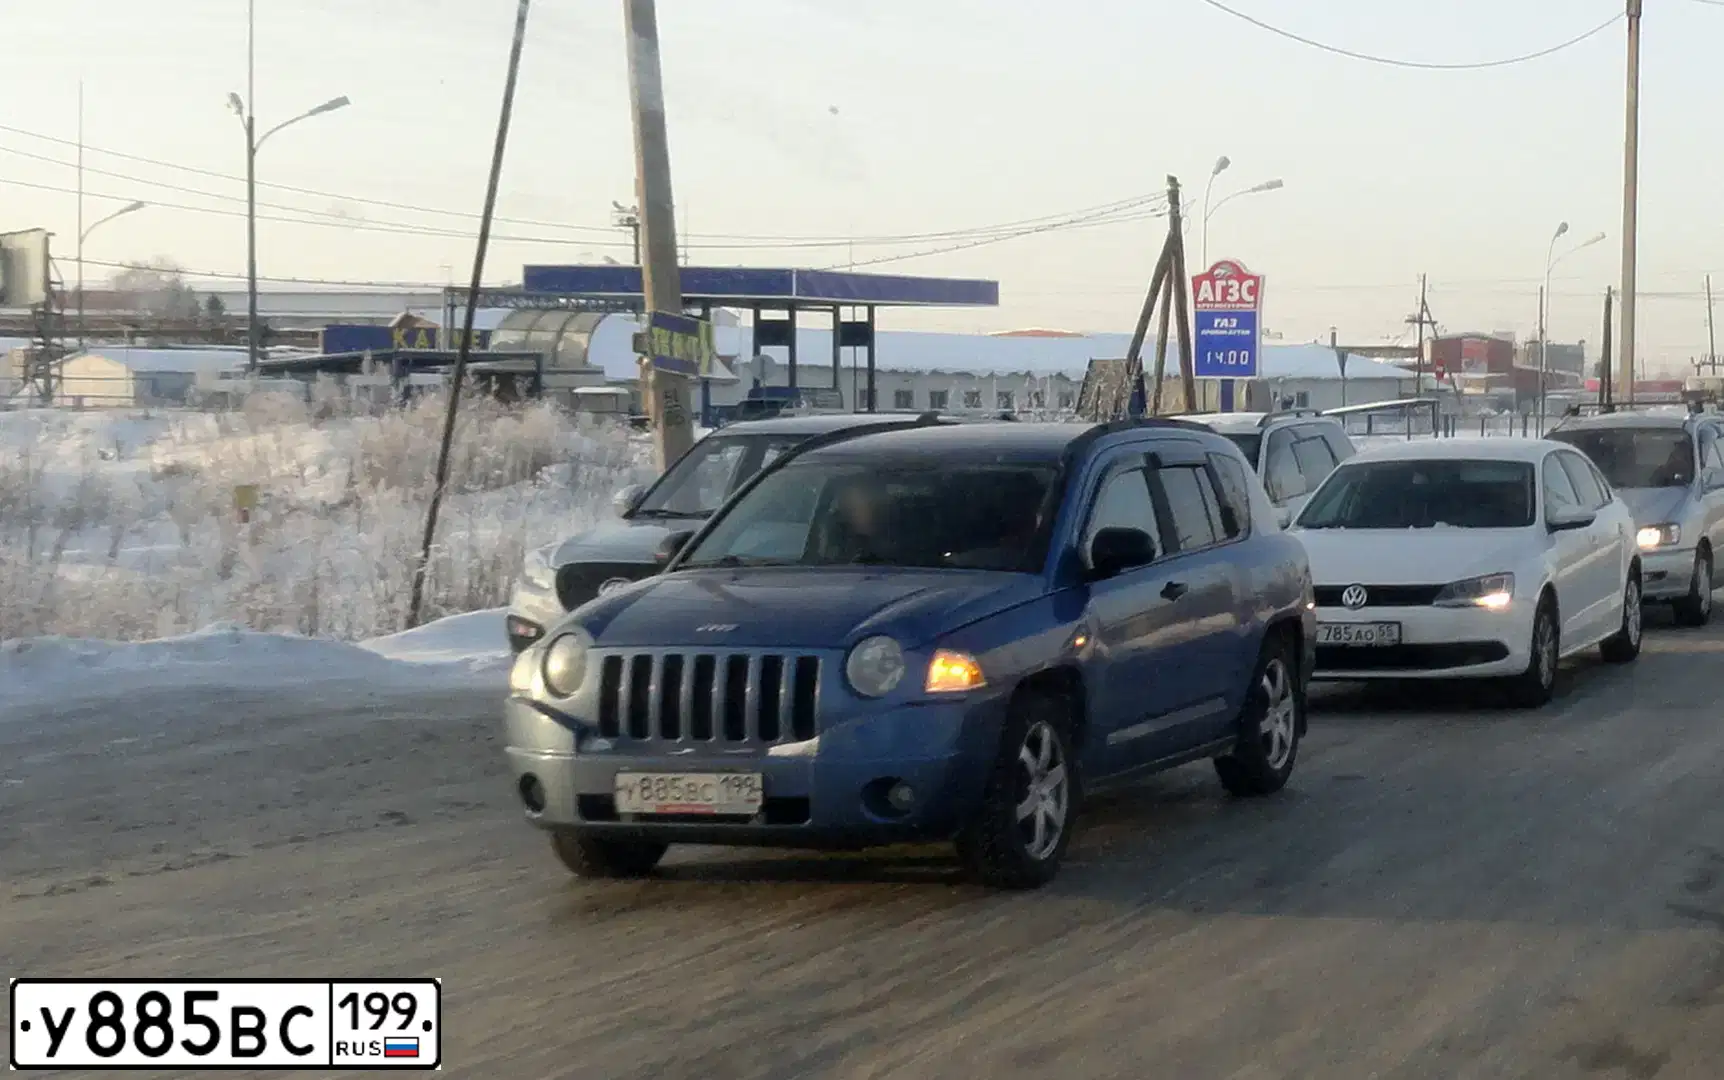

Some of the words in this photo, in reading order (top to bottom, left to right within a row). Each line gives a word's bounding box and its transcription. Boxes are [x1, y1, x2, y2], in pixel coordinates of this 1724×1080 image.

[1197, 279, 1255, 302] АГЗС
[1213, 318, 1238, 328] ГАЗ
[1206, 350, 1249, 365] 14.00
